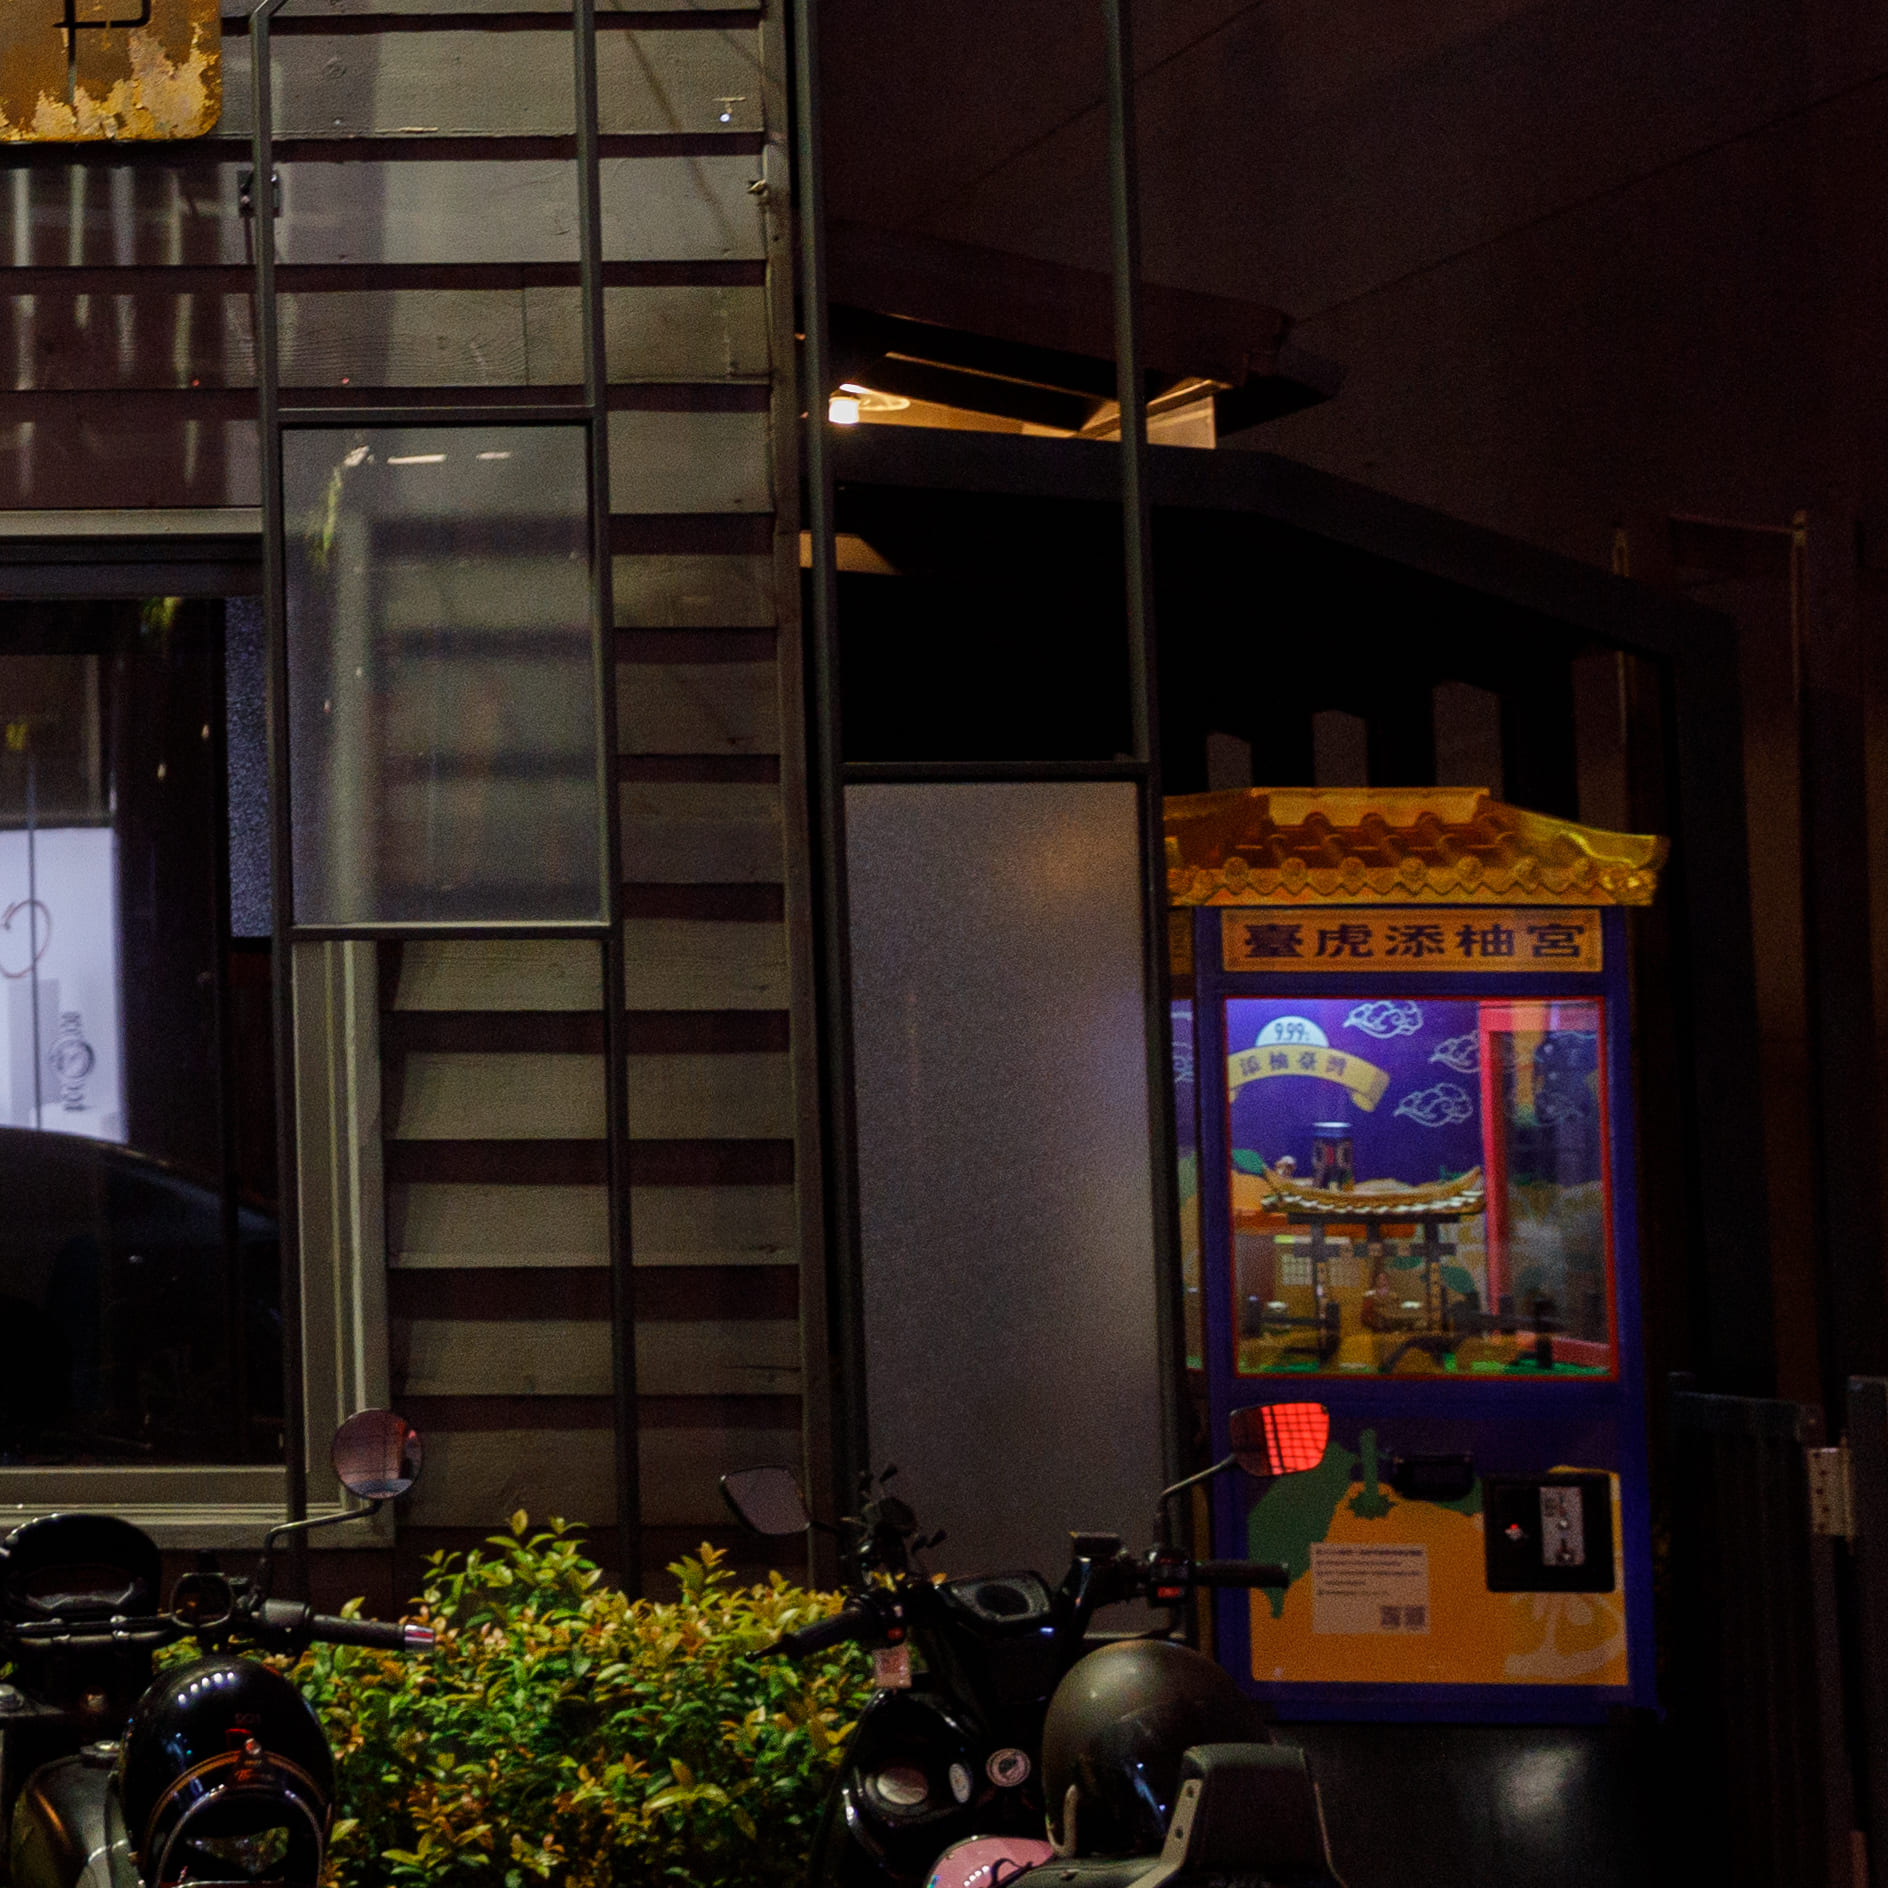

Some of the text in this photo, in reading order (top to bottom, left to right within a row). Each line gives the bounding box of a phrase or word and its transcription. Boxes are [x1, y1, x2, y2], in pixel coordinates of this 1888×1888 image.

[1244, 923, 1586, 959] 臺虎添柚宮
